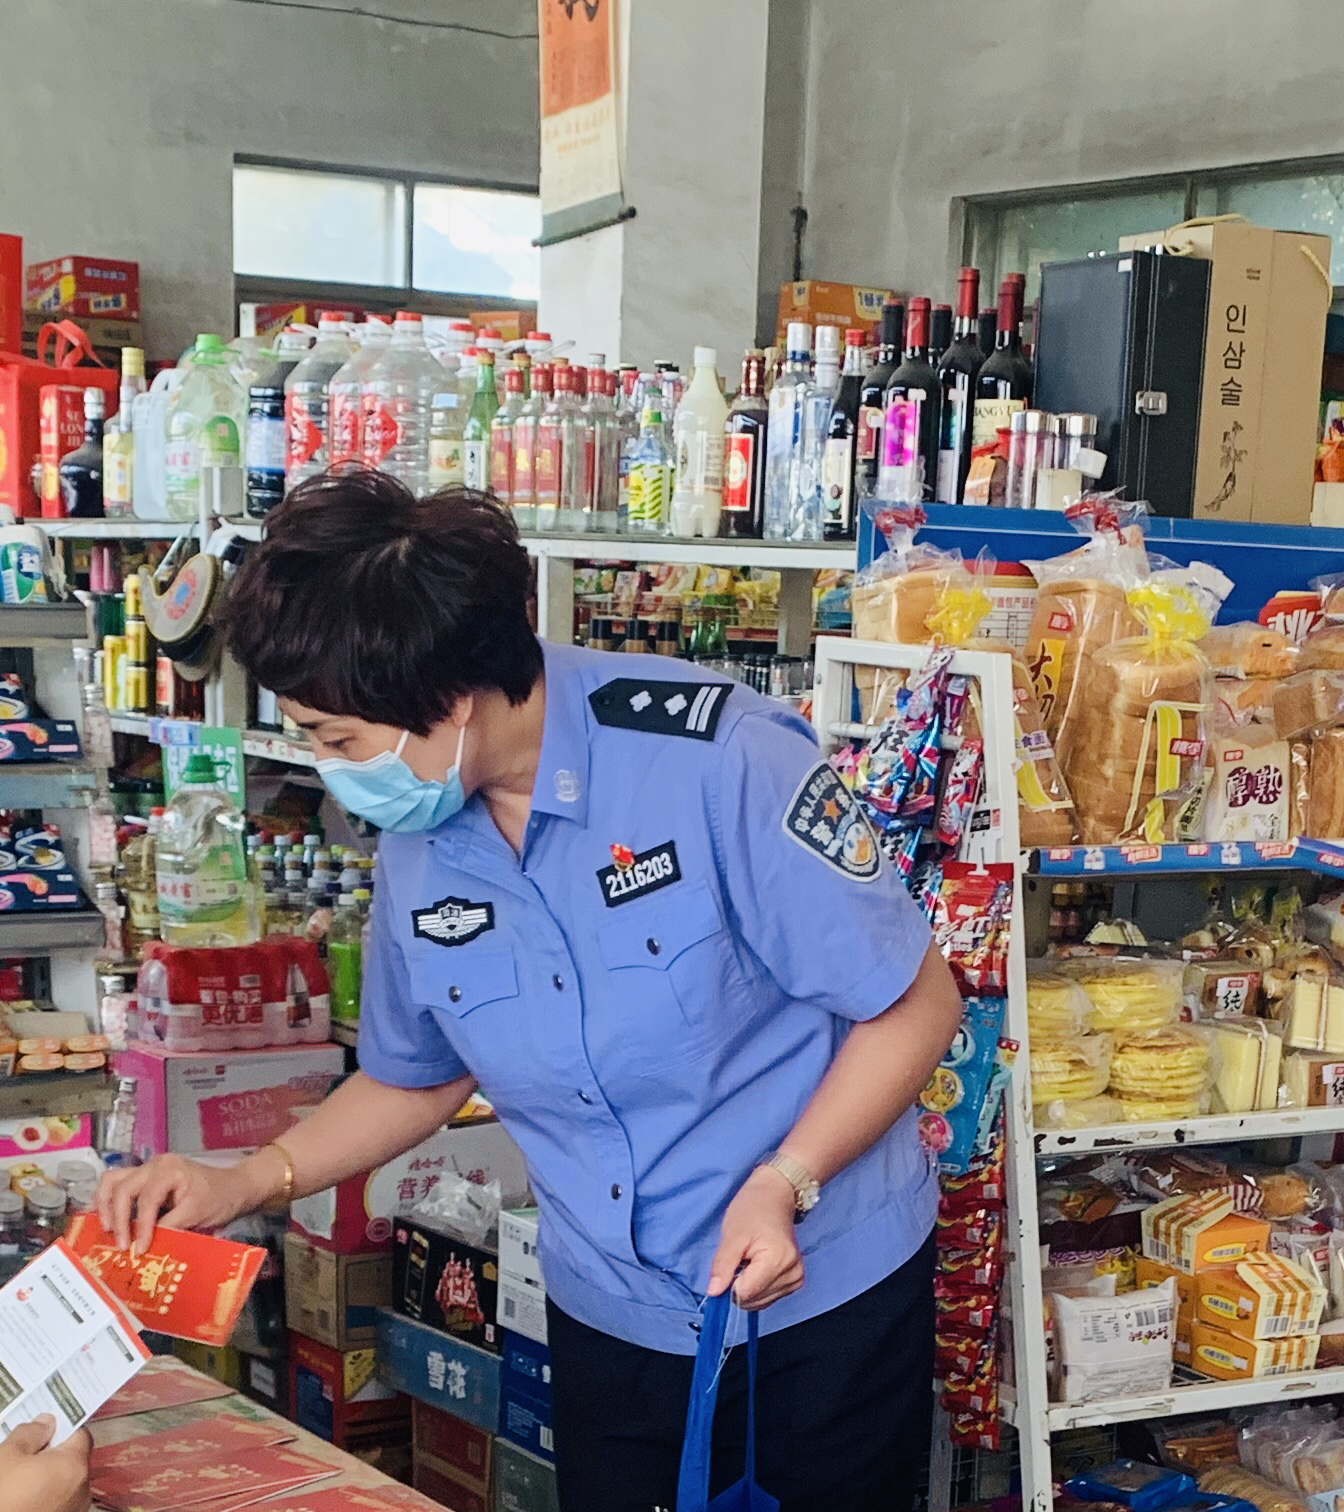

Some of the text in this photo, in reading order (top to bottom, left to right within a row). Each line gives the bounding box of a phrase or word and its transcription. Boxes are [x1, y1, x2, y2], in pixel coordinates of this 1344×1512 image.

[1220, 304, 1246, 406] 인삼술
[1227, 766, 1284, 808] 醇熟
[605, 852, 674, 898] 2116203
[1223, 990, 1246, 1010] 纯
[398, 1168, 488, 1201] 营养线
